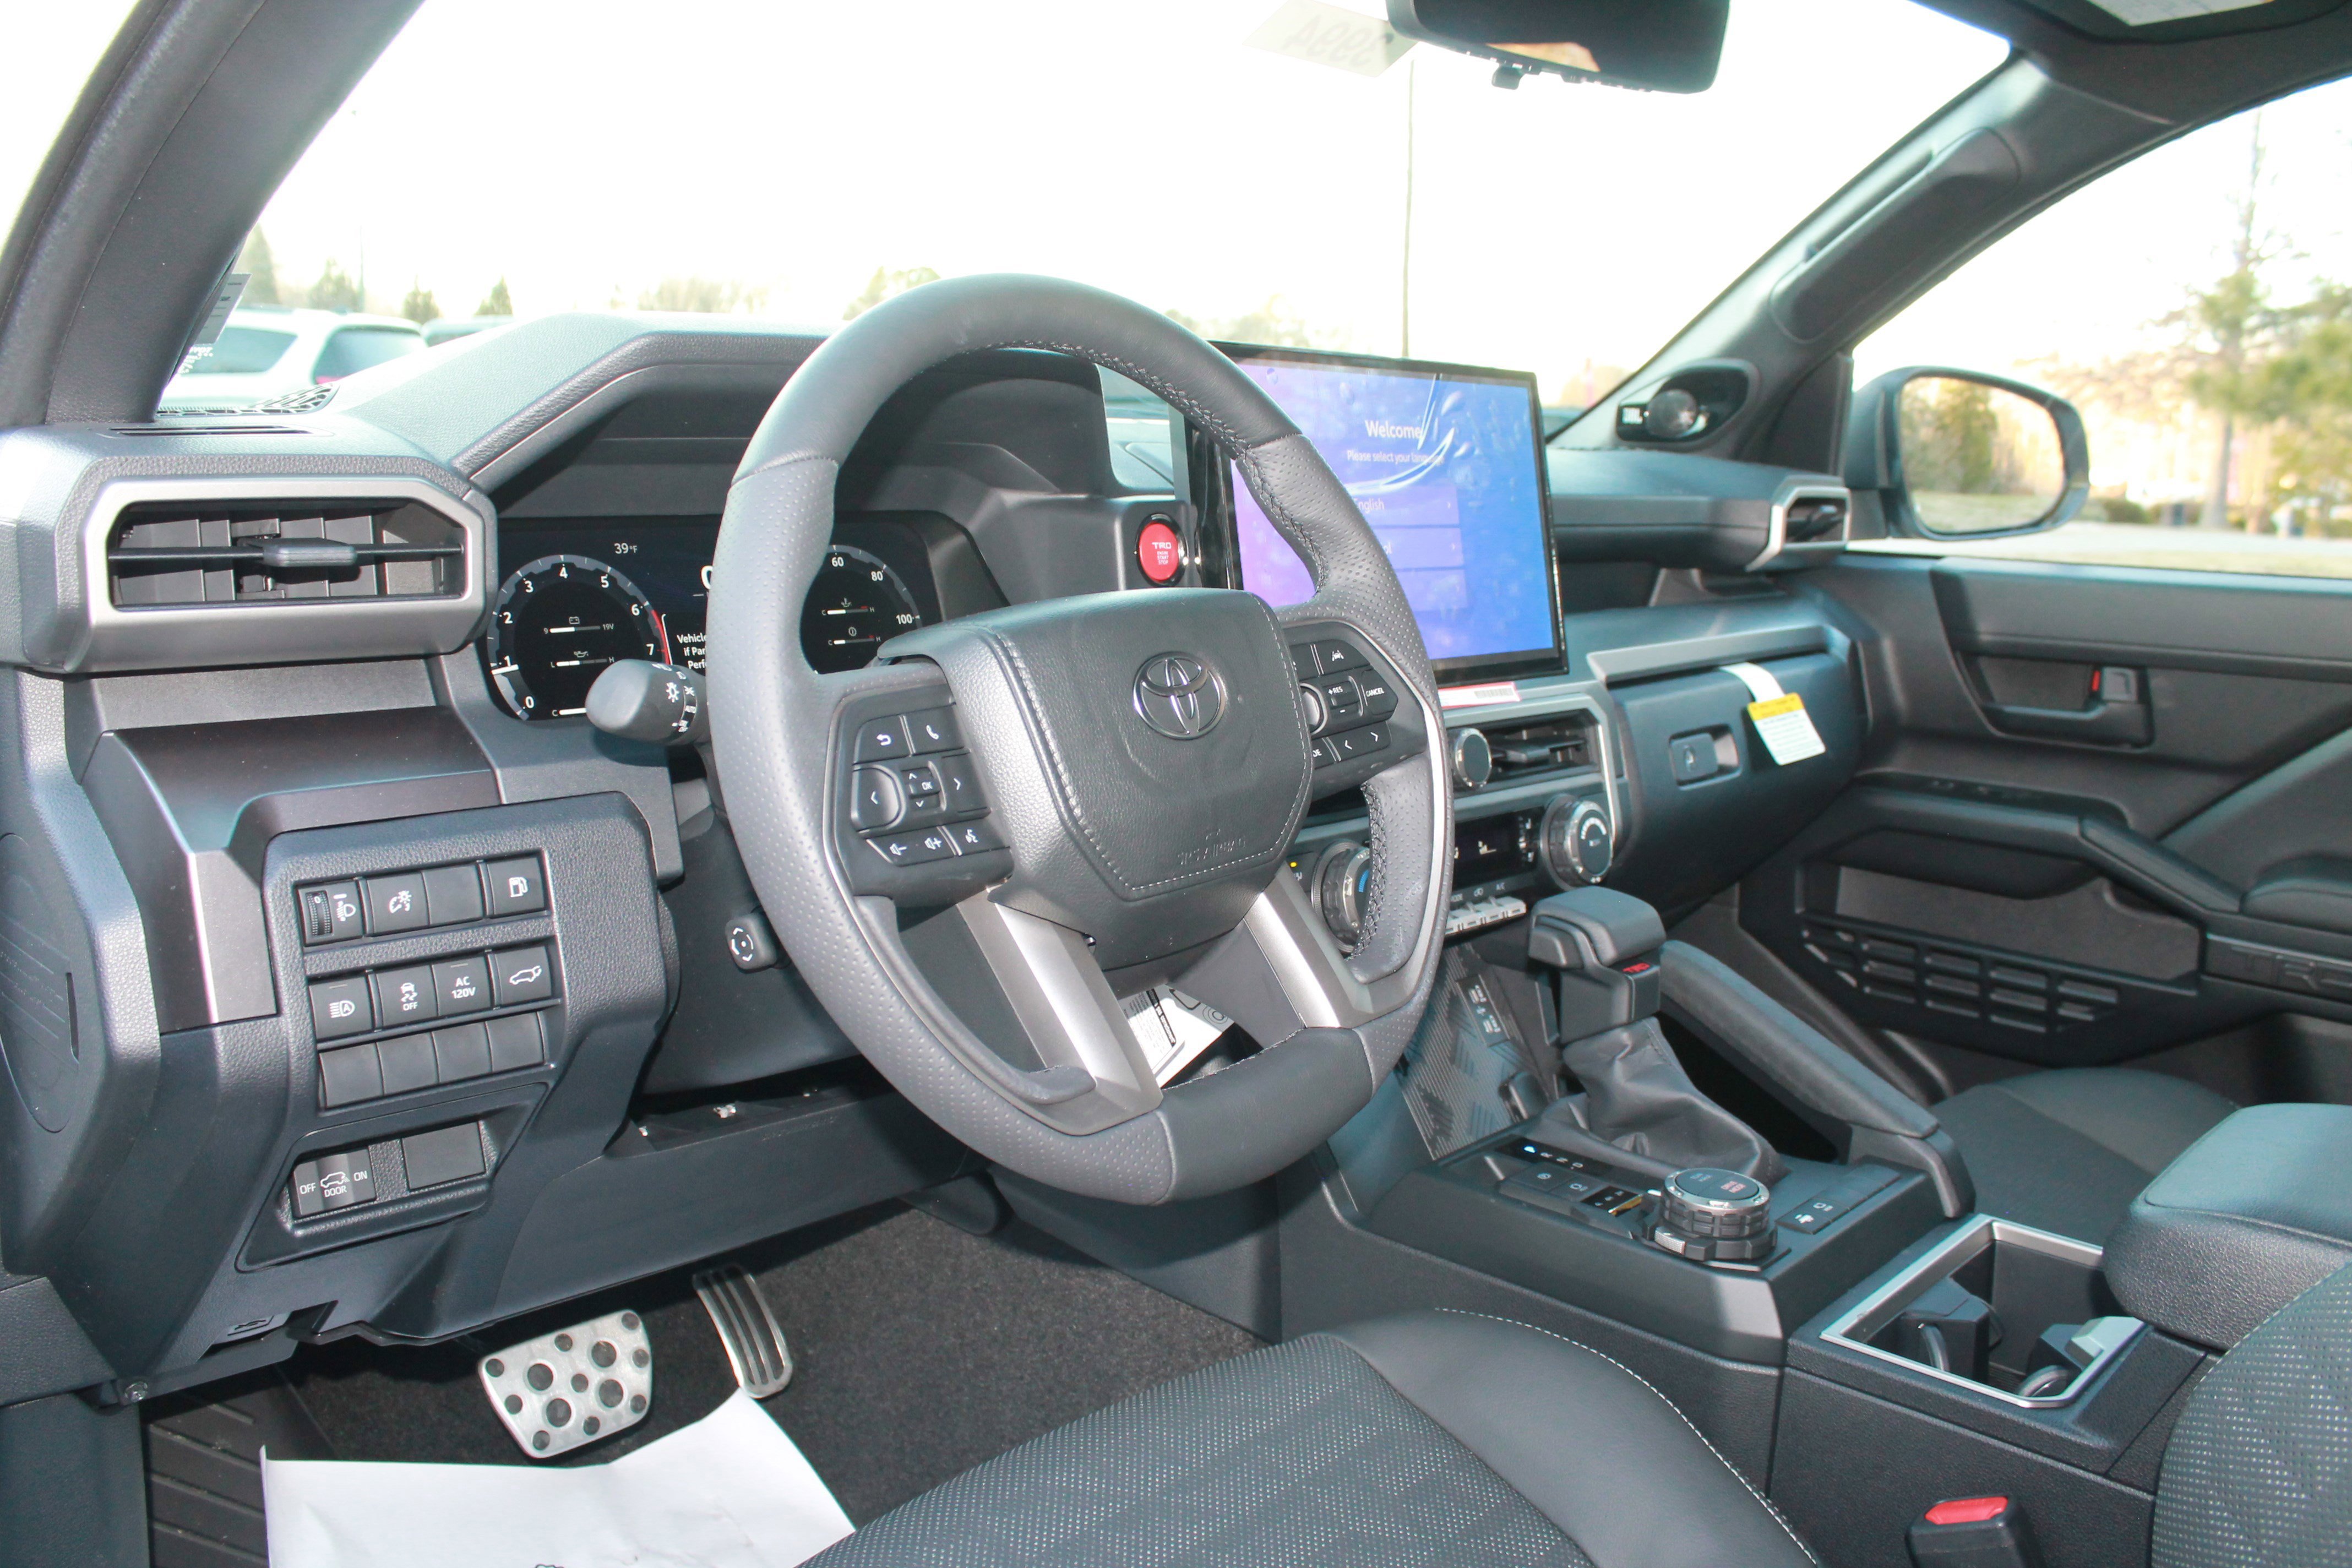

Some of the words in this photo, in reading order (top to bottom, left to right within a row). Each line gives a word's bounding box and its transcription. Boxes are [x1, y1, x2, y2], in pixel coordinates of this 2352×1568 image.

[1365, 420, 1423, 439] Welcome
[1347, 449, 1371, 461] Please
[1373, 451, 1393, 462] select
[1395, 454, 1411, 465] your
[831, 557, 844, 567] 60
[559, 567, 568, 579] 4
[871, 571, 884, 581] 80
[525, 581, 534, 593] 3
[601, 576, 609, 589] 5
[631, 604, 640, 616] 6
[504, 612, 513, 624] 2
[896, 614, 912, 624] 100
[646, 644, 654, 656] 7
[683, 646, 690, 656] if
[692, 646, 707, 655] Par
[504, 656, 511, 667] 1
[688, 659, 707, 669] Perf
[1366, 687, 1385, 698] CANCEL
[525, 696, 534, 708] 0
[922, 781, 933, 791] OK
[455, 976, 471, 988] AC
[451, 986, 476, 999] 120V
[402, 1000, 419, 1011] OFF
[353, 1170, 368, 1182] ON
[300, 1181, 316, 1195] OFF
[324, 1183, 347, 1198] DOOR
